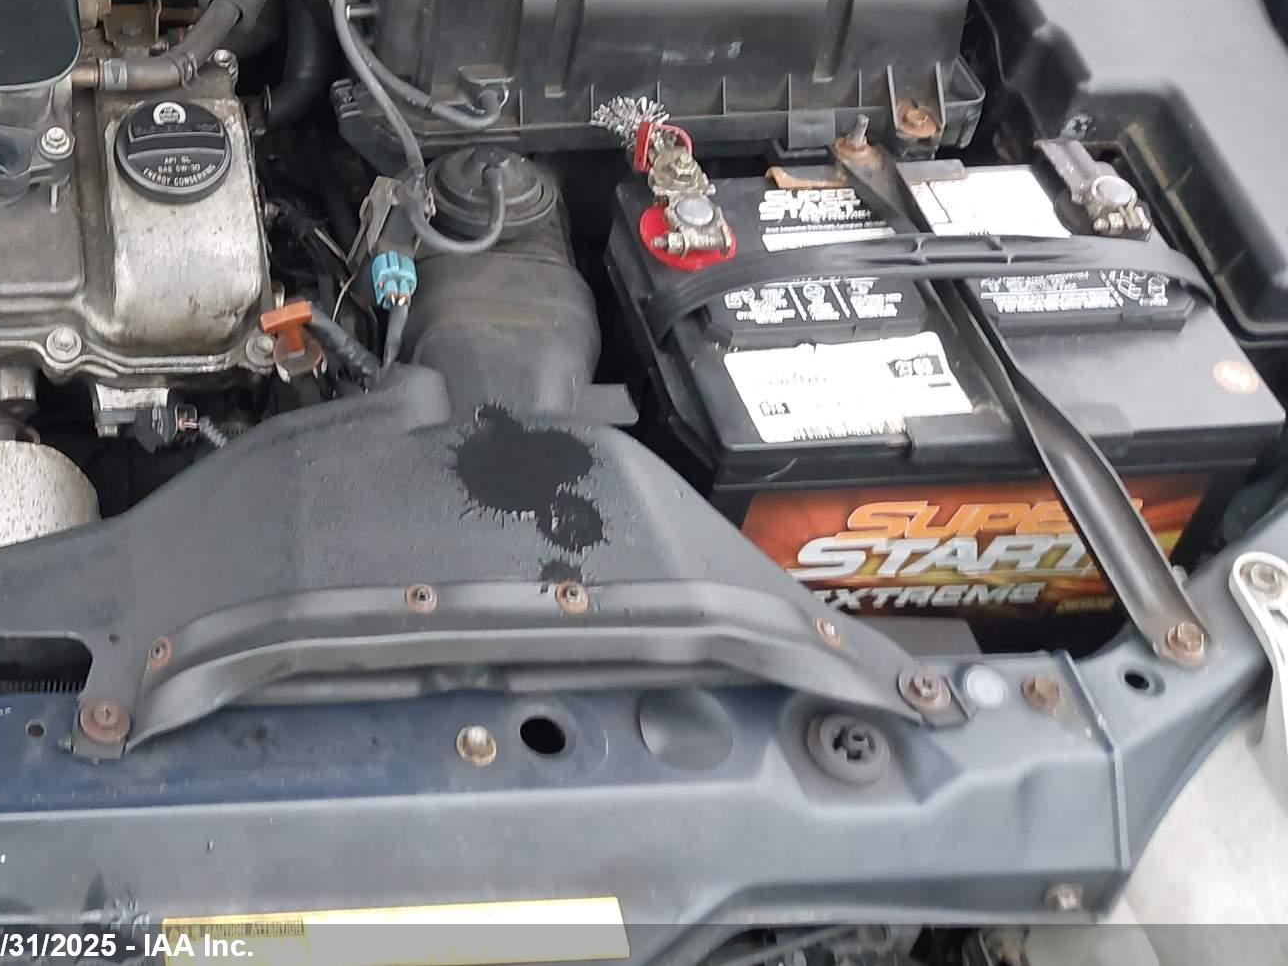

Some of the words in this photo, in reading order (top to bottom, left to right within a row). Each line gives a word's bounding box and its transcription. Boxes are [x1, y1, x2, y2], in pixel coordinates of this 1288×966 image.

[143, 167, 172, 185] ENERGY
[764, 187, 857, 203] SUPER
[836, 499, 1143, 541] SUPE
[788, 535, 1091, 580] START
